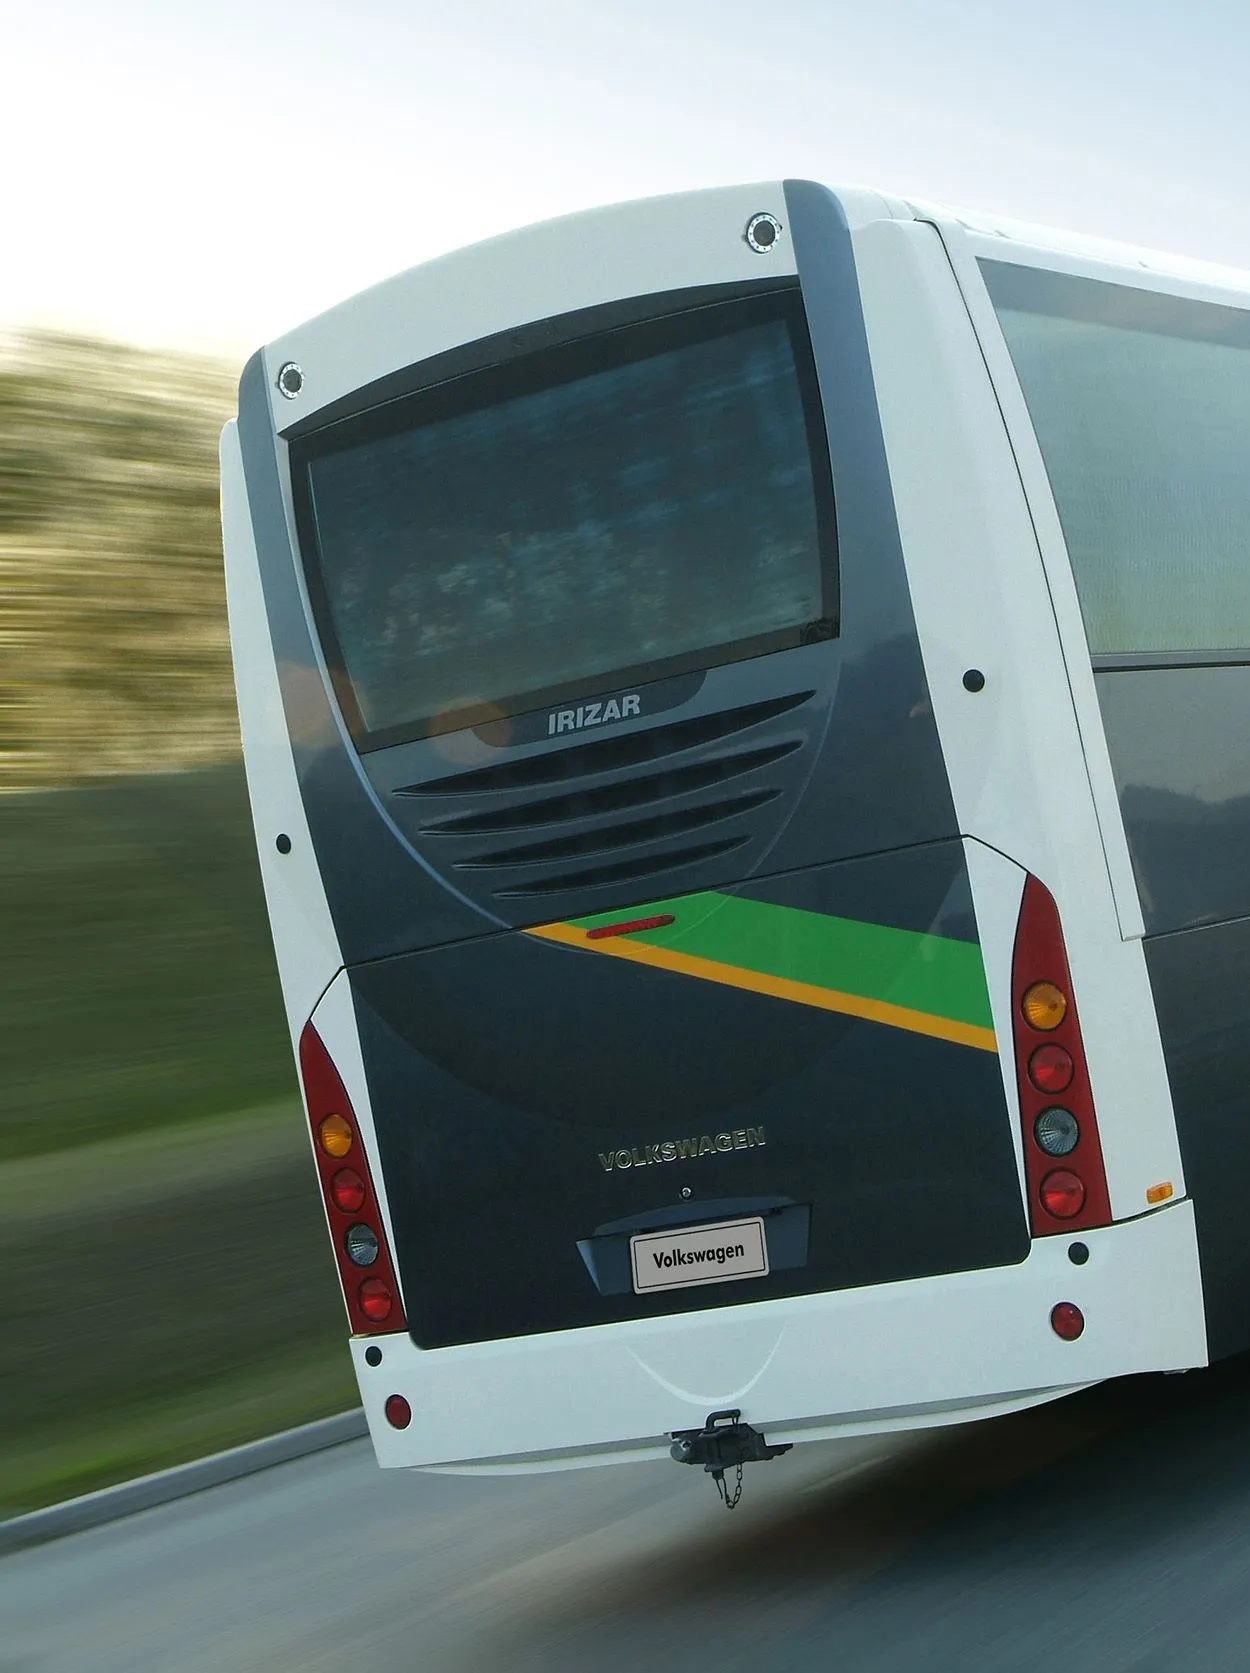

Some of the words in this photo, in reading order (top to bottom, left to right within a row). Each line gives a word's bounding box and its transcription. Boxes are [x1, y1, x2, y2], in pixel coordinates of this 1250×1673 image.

[548, 694, 640, 735] IRIZAR
[598, 1126, 766, 1172] VOLKSWAGEN
[652, 1243, 745, 1269] Volkswagen
